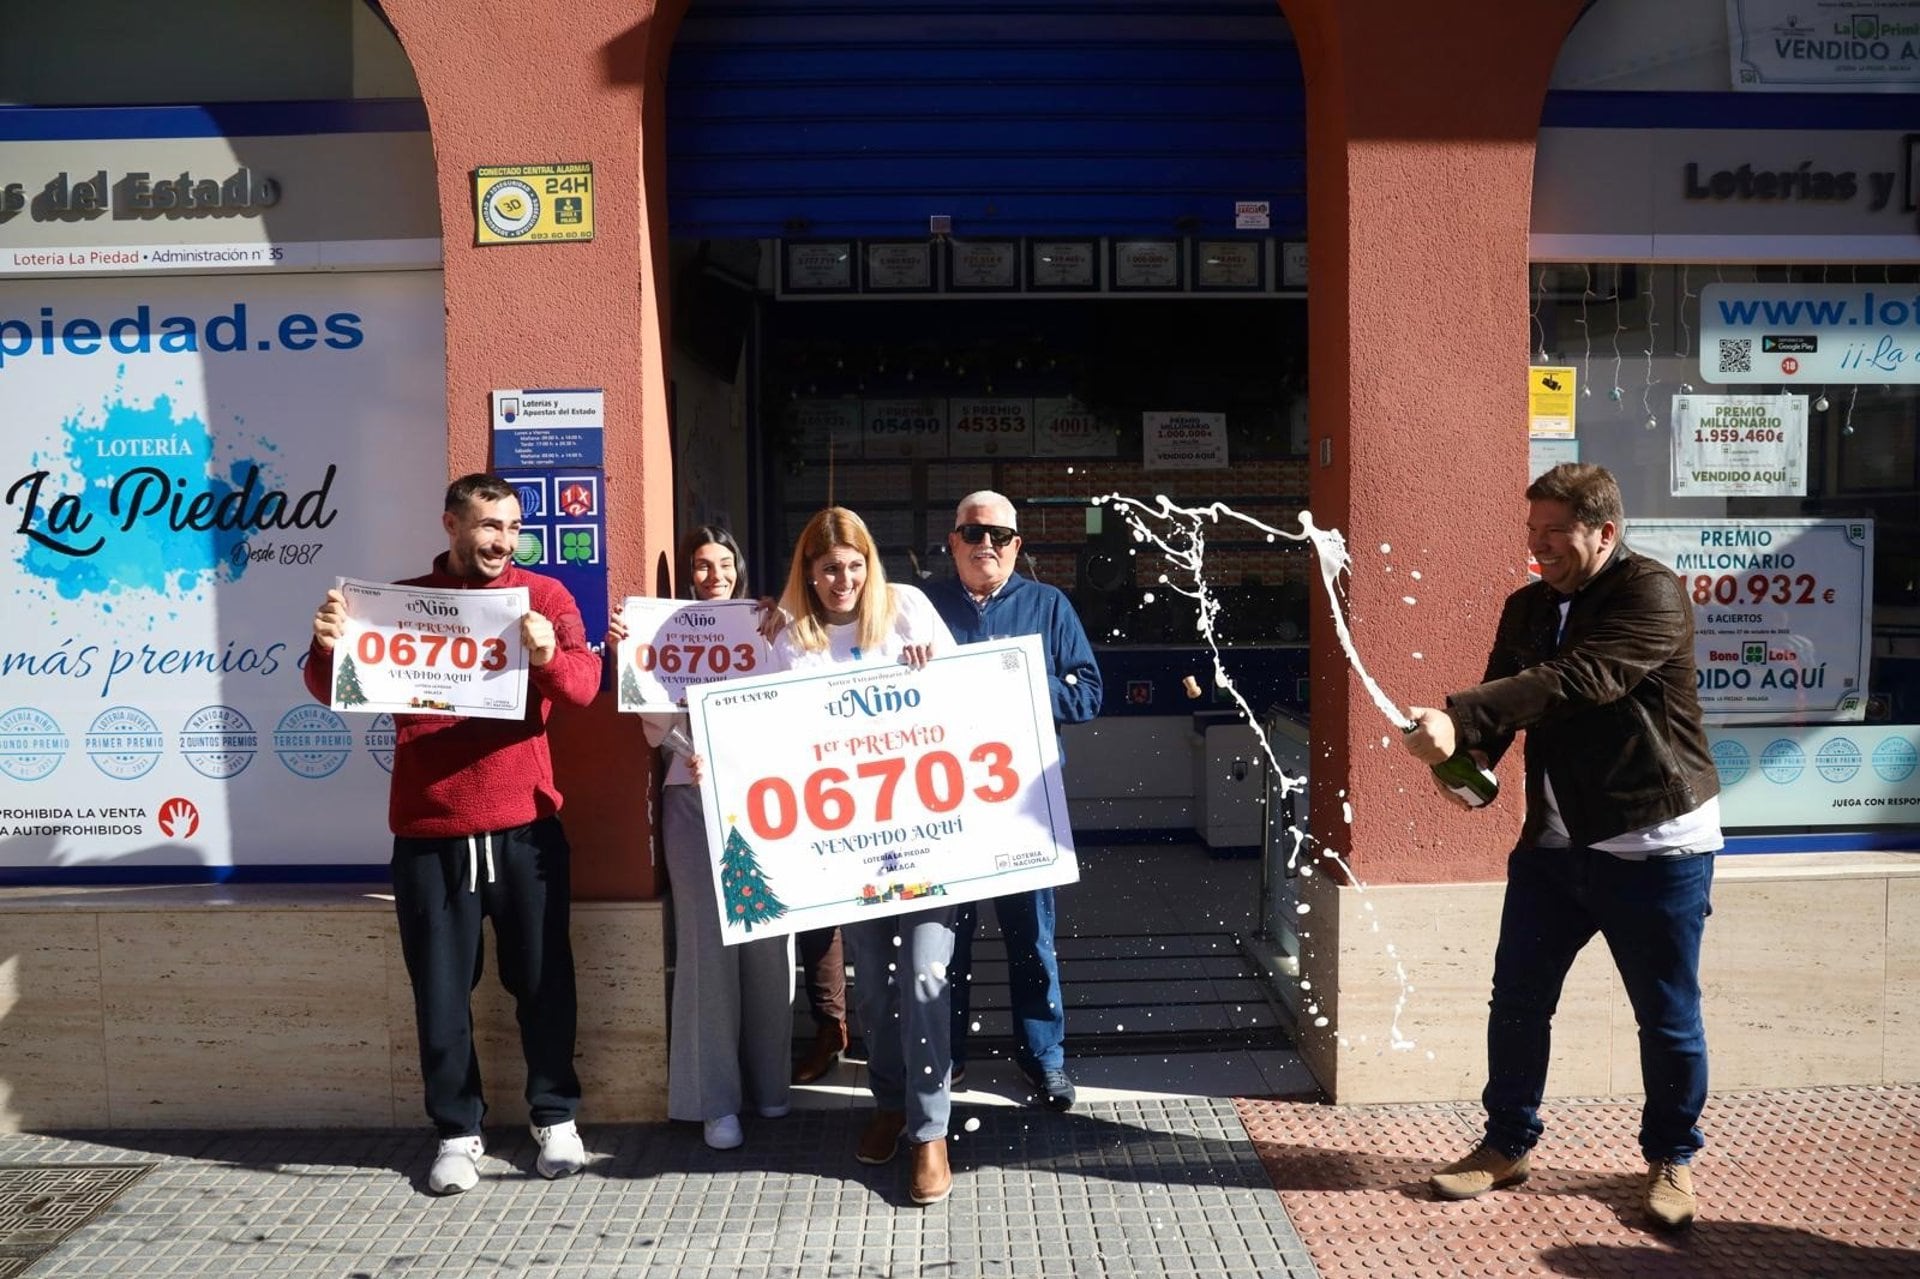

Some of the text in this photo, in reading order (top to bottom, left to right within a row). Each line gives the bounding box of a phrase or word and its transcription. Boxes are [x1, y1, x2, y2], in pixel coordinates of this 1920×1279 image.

[1775, 39, 1920, 60] VENDIDO A
[478, 164, 590, 176] CONECTADO CENTRAL ALARMAS
[40, 170, 109, 213] del
[121, 168, 281, 212] Estado
[545, 177, 588, 194] 24H
[1685, 161, 1895, 211] Loterías y
[502, 199, 522, 212] 3D
[69, 252, 85, 265] La
[91, 250, 139, 264] Piedad
[269, 247, 283, 260] 35
[523, 409, 556, 417] Apuestas
[571, 407, 596, 415] Estado
[972, 405, 1022, 416] PREMIO
[1716, 407, 1765, 417] PREMIO
[872, 418, 941, 434] 05490
[958, 417, 1026, 433] 45353
[1700, 418, 1781, 428] MILLONARIO
[97, 433, 193, 457] LOTERÍA
[1692, 467, 1786, 483] VENDIDO AQUÍ
[6, 464, 338, 557] La Piedad
[1701, 531, 1772, 547] PREMIO
[232, 542, 323, 567] Desde 1987
[1676, 554, 1795, 569] MILLONARIO
[1681, 574, 1816, 606] 80.932
[414, 599, 459, 616] Niño
[681, 612, 716, 628] Niño
[1707, 614, 1762, 623] 6 ACIERTOS
[416, 622, 470, 634] PREMIO
[679, 633, 725, 643] PREMIO
[357, 631, 508, 671] 06703
[635, 643, 756, 673] 06703
[1709, 651, 1739, 661] Bono
[2, 639, 286, 698] más premios
[389, 669, 441, 681] VENDIDO
[1761, 663, 1826, 689] AQUÍ
[722, 696, 738, 705] DE
[741, 690, 778, 702] ENERO
[824, 684, 921, 718] El Niño
[193, 711, 230, 729] NAVIDAD
[0, 739, 69, 749] UNDO PREMIO
[86, 737, 163, 748] PRIMER PREMIO
[187, 737, 219, 747] QUINTOS
[222, 736, 257, 747] PREMIOS
[274, 735, 352, 746] TERCER PREMIO
[365, 735, 396, 746] SEGUN
[813, 724, 945, 761] 1er PREMIO
[746, 742, 1020, 840] 06703
[1832, 799, 1861, 807] JUEGA
[1865, 798, 1884, 806] CON
[77, 809, 96, 818] LA
[99, 808, 147, 818] VENTA
[14, 825, 142, 836] AUTOPROHIBIDOS
[810, 815, 963, 857] VENDIDO AQUÍ
[893, 852, 903, 860] LA
[904, 848, 931, 857] PIEDAD
[1013, 856, 1051, 867] NACIONAL
